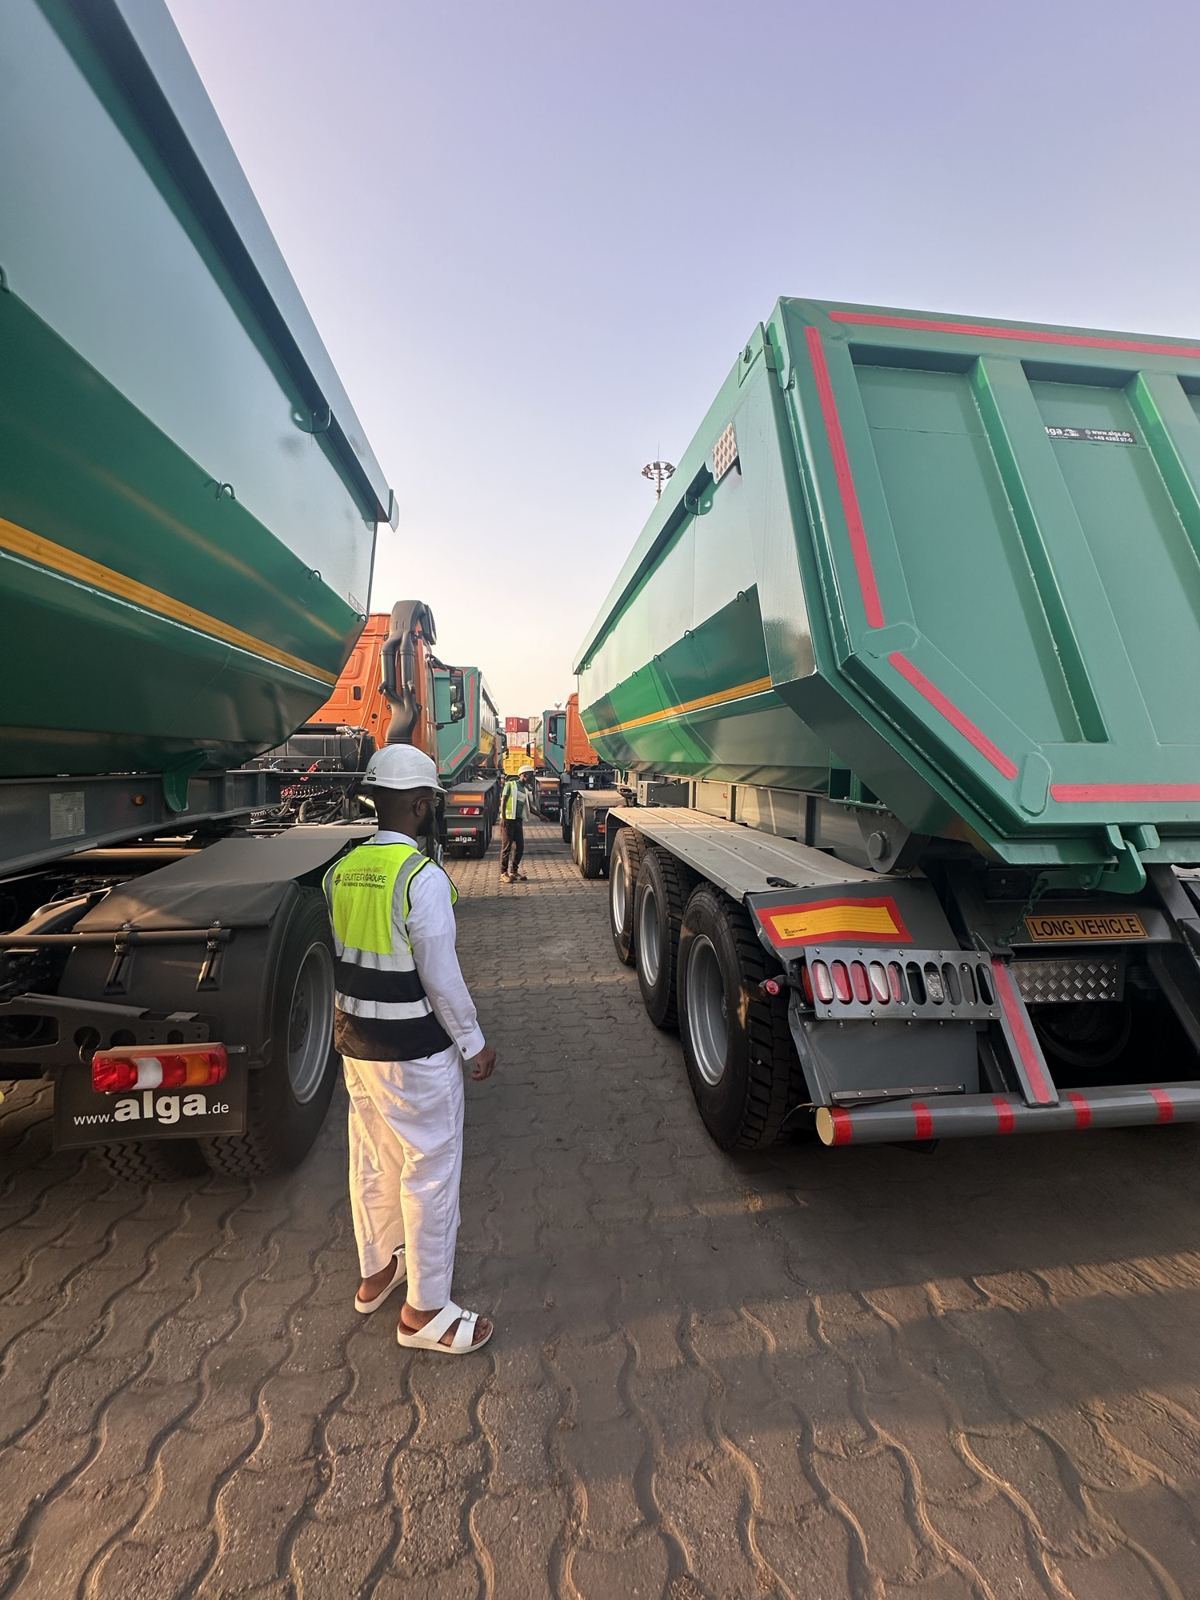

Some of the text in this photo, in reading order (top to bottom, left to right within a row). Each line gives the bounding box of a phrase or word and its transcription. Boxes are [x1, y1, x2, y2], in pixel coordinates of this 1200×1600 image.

[1044, 426, 1063, 436] lga
[1031, 918, 1140, 937] LONG VEHICLE
[73, 1090, 229, 1124] www.alga.de
